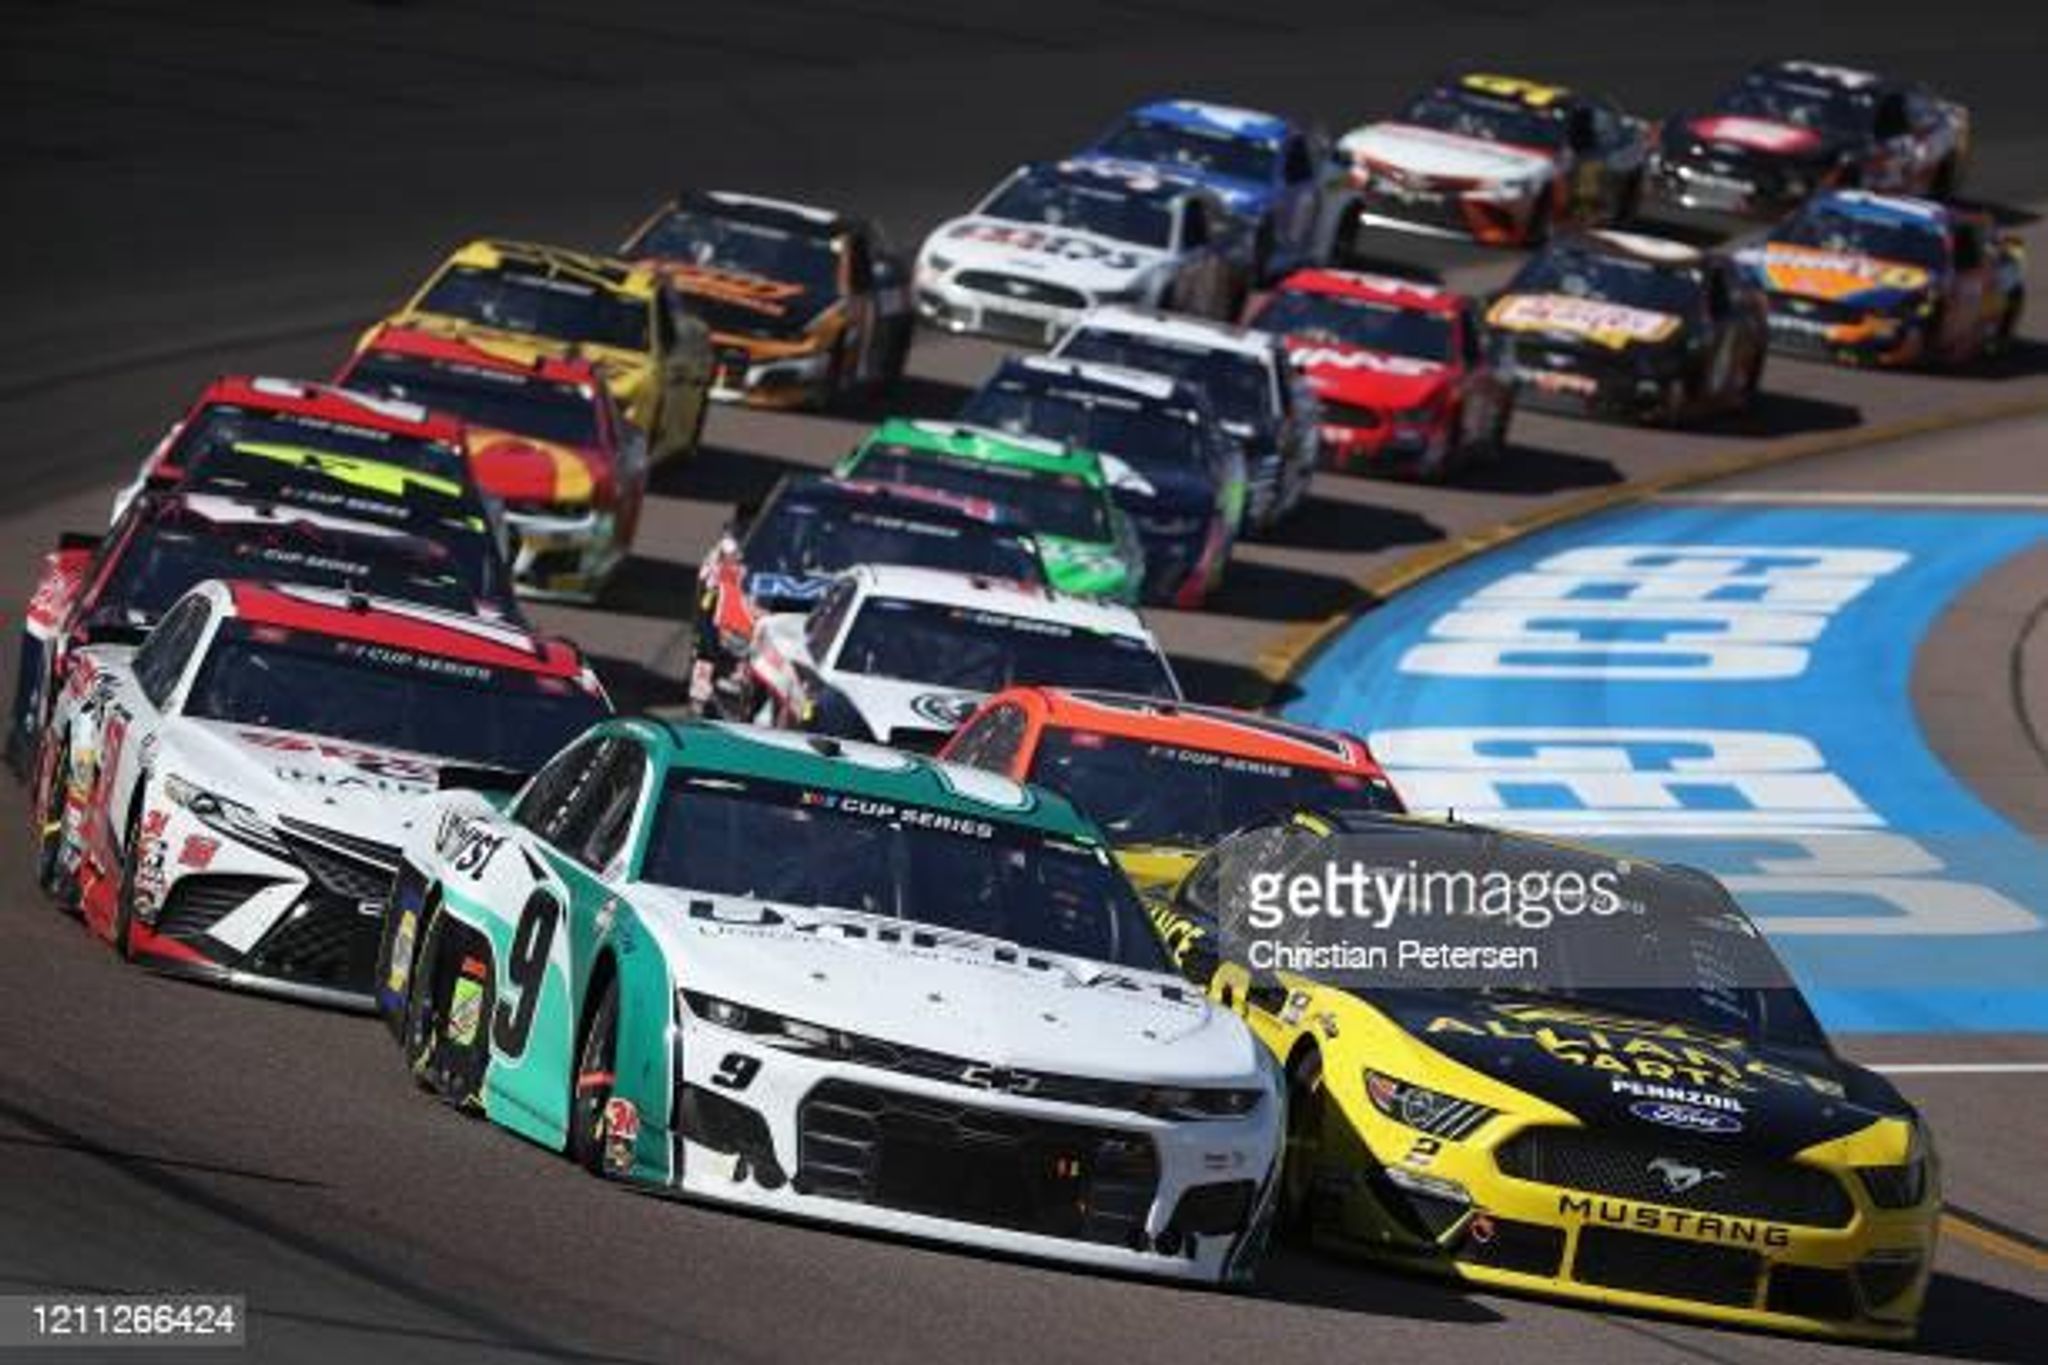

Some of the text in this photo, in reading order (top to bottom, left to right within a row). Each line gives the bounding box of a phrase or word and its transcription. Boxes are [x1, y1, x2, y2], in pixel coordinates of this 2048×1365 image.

[841, 797, 993, 839] CUP SERIES
[491, 886, 560, 1059] 9
[710, 1051, 763, 1092] 9
[1610, 1077, 1747, 1114] PENNZOIL
[1558, 1193, 1790, 1248] MUSTANG
